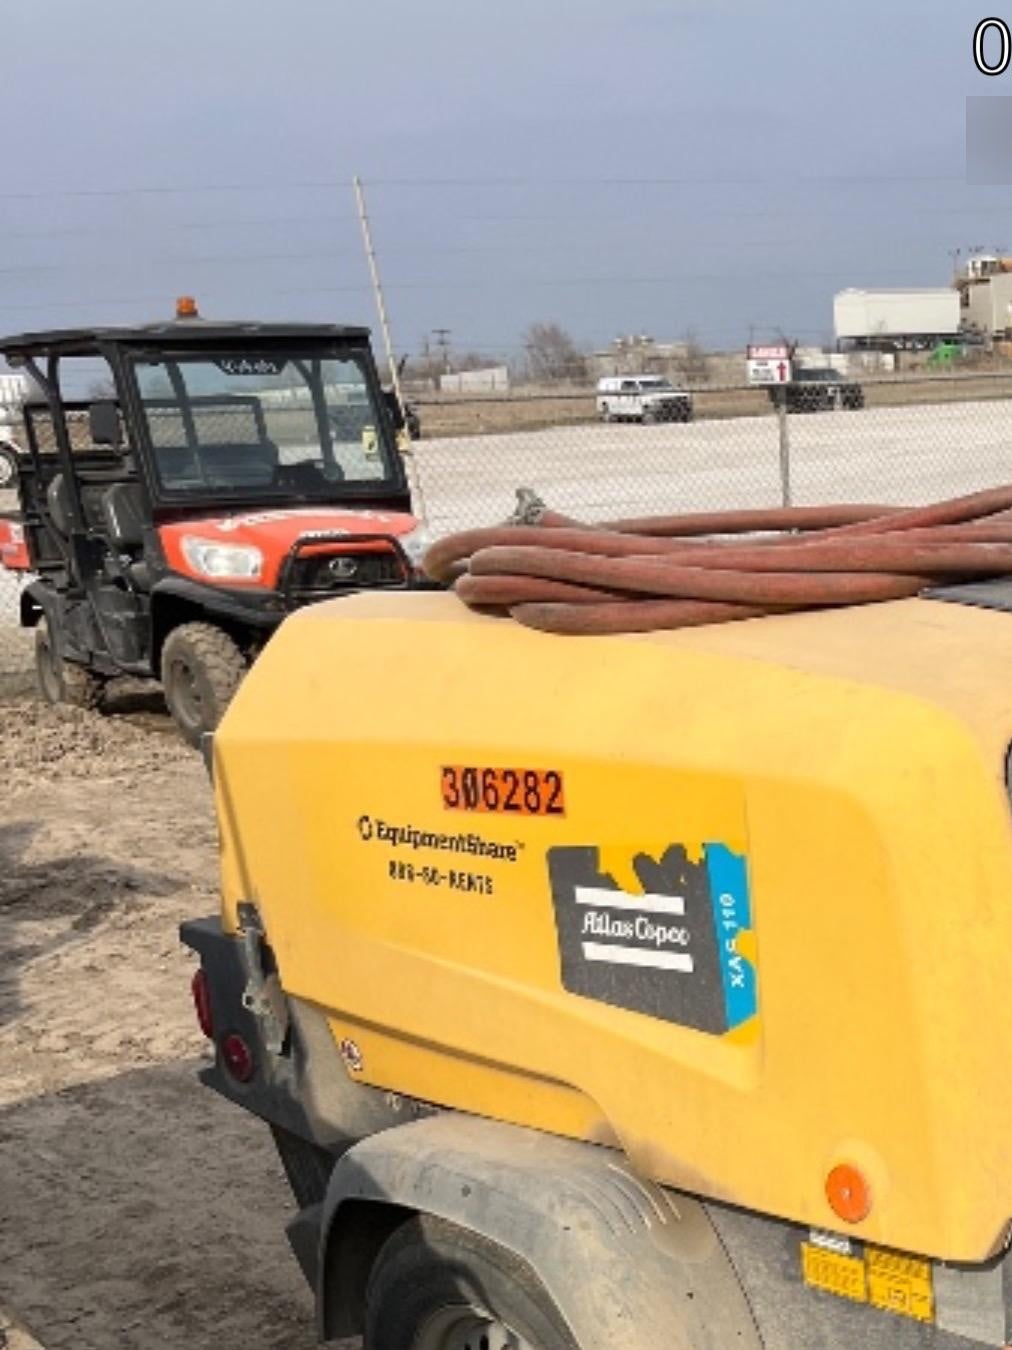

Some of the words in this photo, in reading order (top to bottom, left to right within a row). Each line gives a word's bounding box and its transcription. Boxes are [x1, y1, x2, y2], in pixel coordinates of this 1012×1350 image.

[442, 767, 564, 814] 306282
[581, 911, 633, 939] Atlas
[635, 916, 690, 947] Copco
